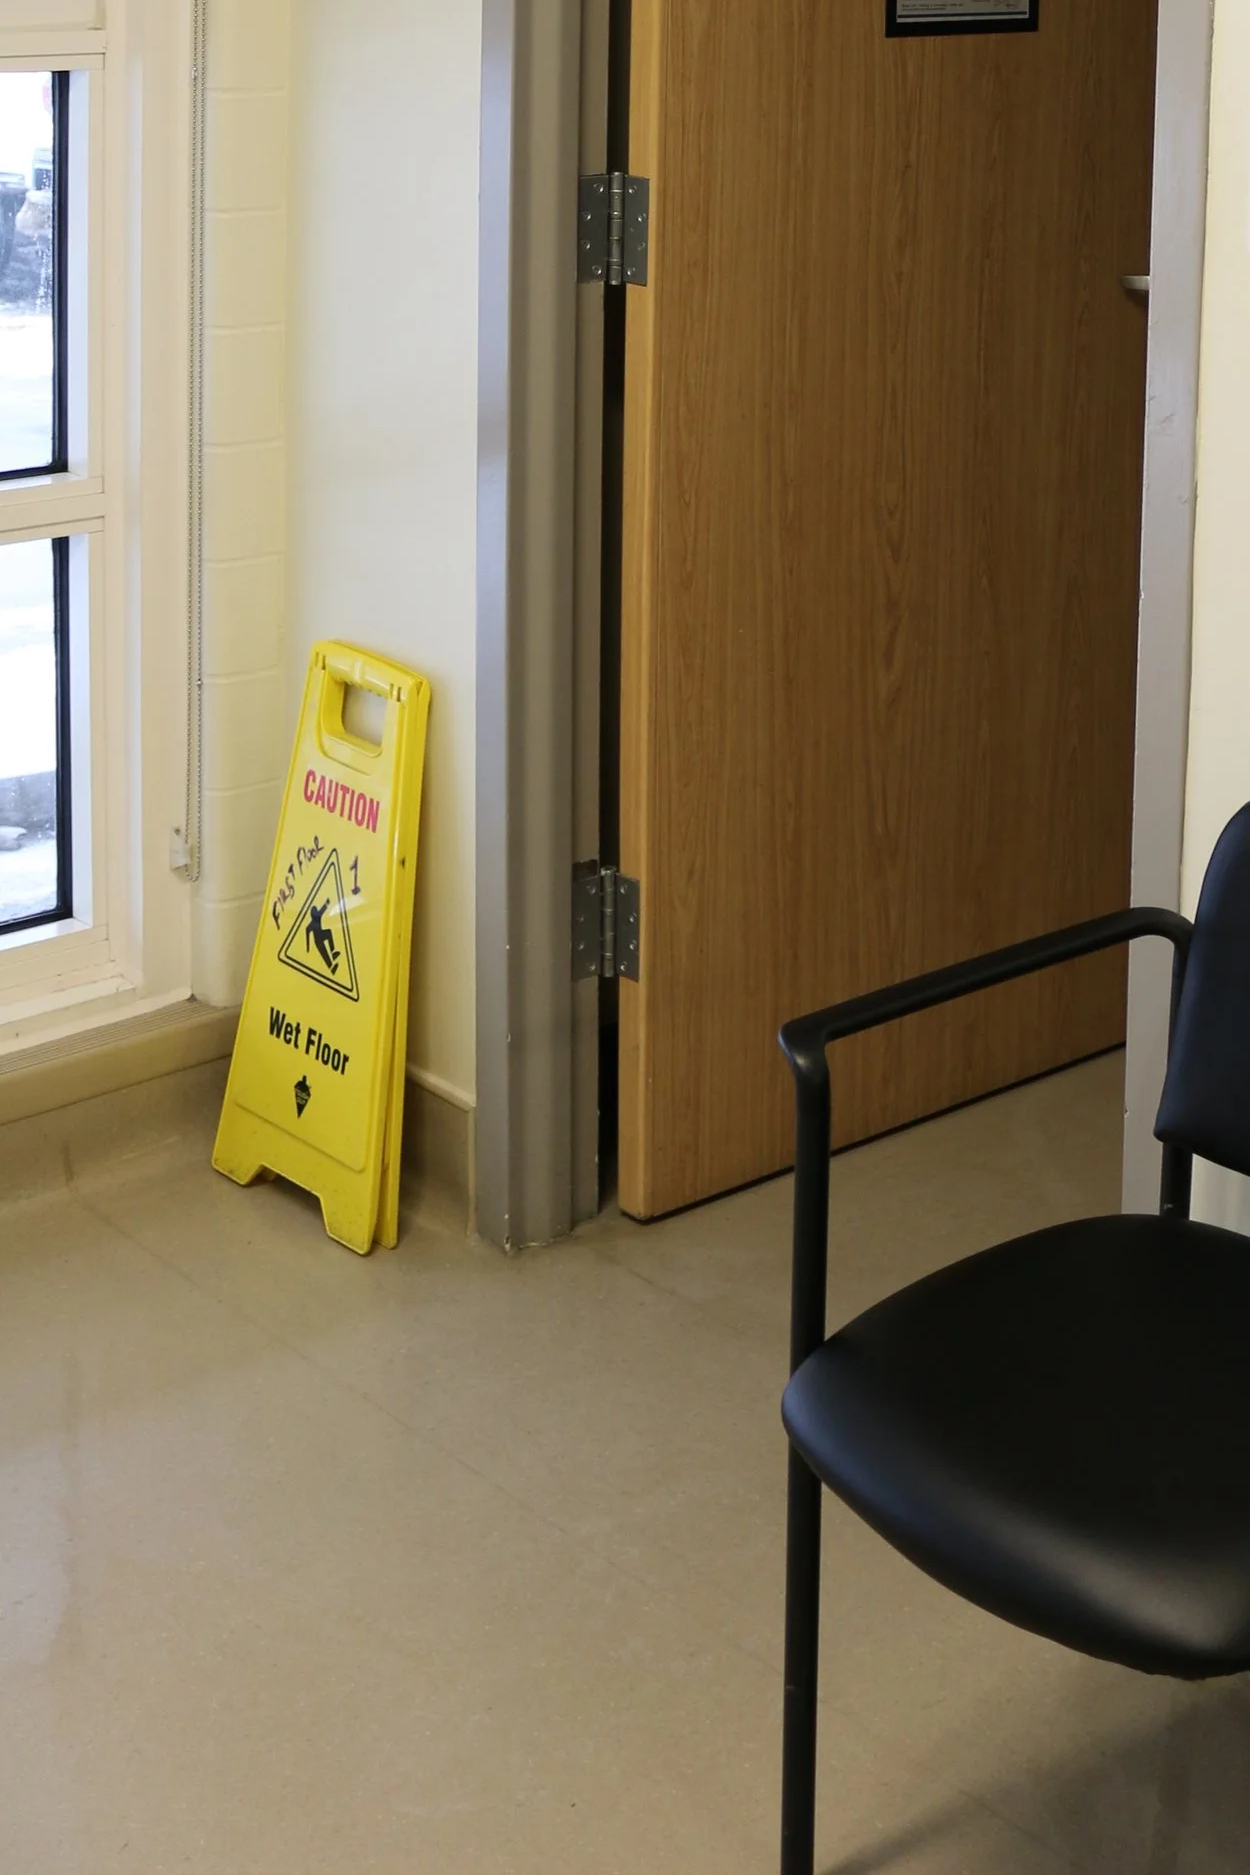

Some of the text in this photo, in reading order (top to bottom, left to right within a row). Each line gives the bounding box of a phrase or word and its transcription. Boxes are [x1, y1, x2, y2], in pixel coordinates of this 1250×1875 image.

[303, 769, 380, 833] CAUTION
[272, 863, 296, 931] FIRST
[269, 1006, 350, 1076] Wet Floor
